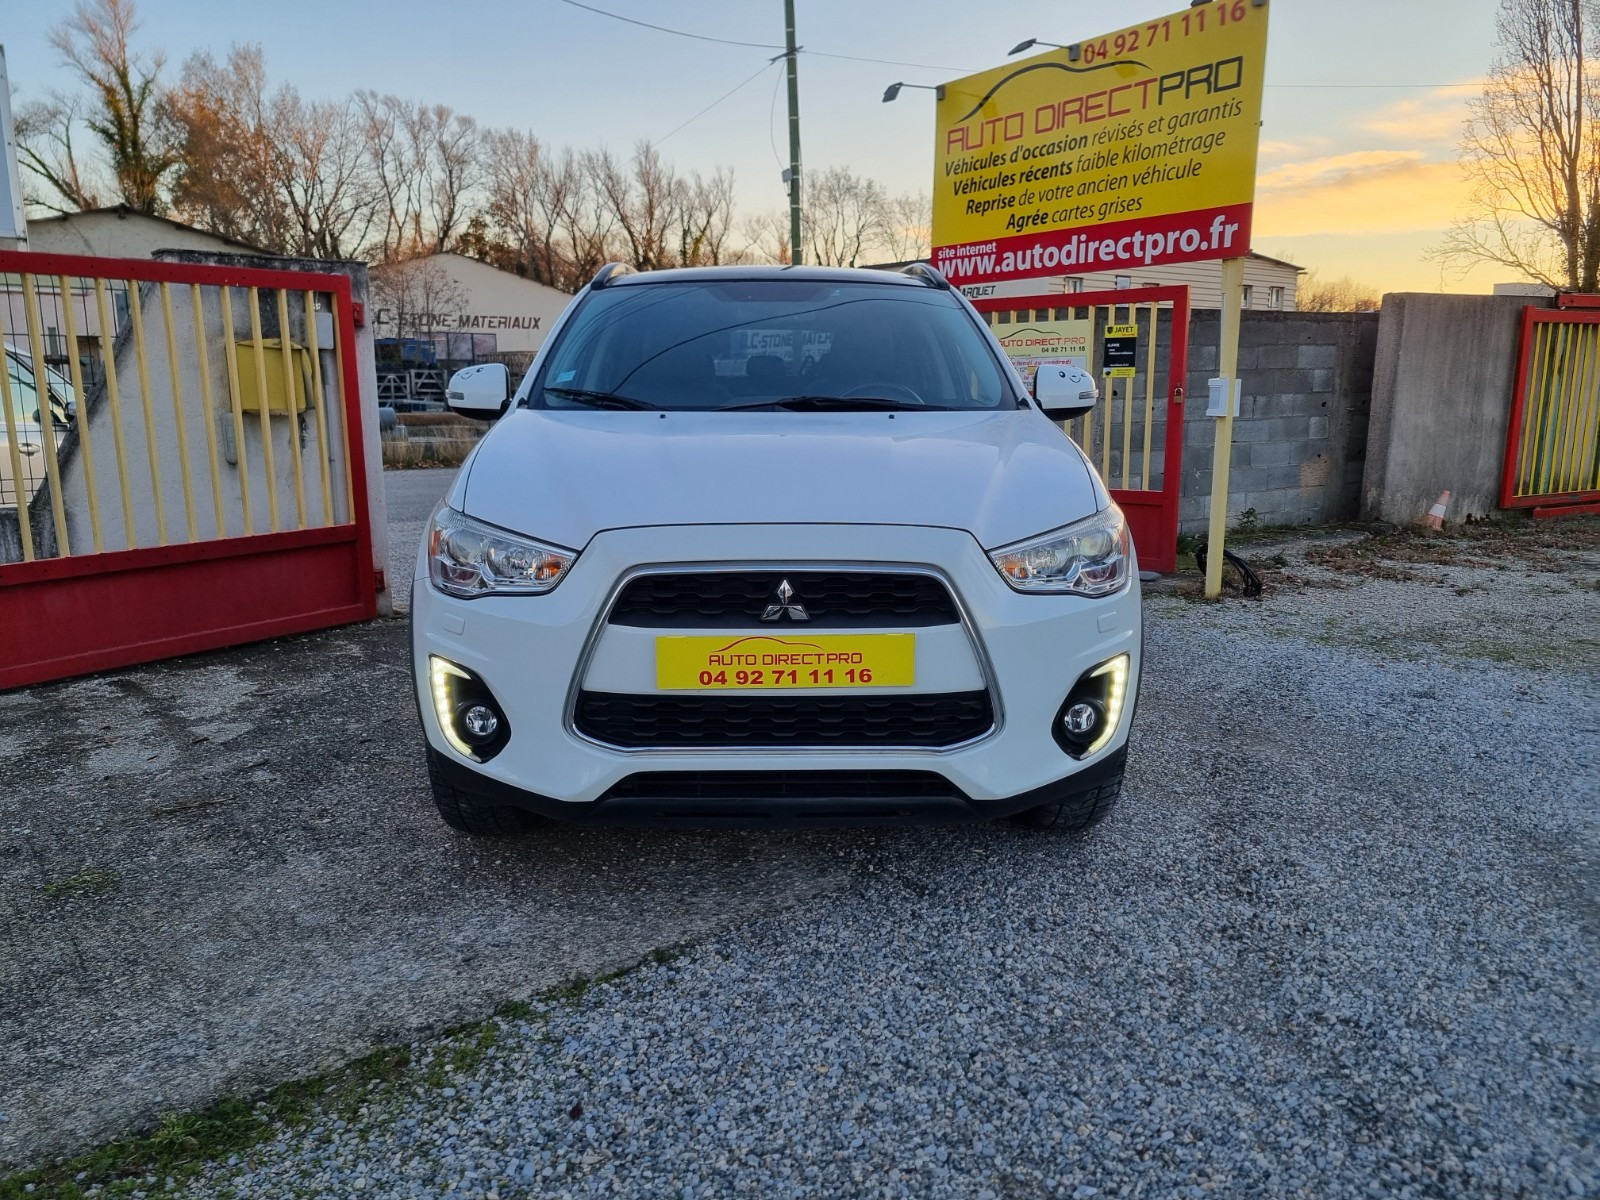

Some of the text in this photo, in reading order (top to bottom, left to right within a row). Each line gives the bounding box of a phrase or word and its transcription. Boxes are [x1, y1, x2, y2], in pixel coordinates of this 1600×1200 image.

[1083, 0, 1247, 64] 04 92 71 11 16
[945, 97, 1243, 177] Véhicules d'occasion révisés et garantis
[947, 112, 1024, 155] AUTO
[953, 131, 1226, 196] Véhicules récents faible kilométrage
[966, 158, 1202, 217] Reprise de votre ancien véhicule
[1006, 196, 1143, 233] Agrée cartes grises
[938, 214, 1239, 278] www.autodirectpro.fr
[938, 241, 997, 259] site internet
[960, 285, 996, 298] ARQUET
[999, 336, 1086, 348] AUTO DIRECT PRO
[699, 668, 873, 686] 04 92 71 11 16
[709, 653, 757, 666] AUTO
